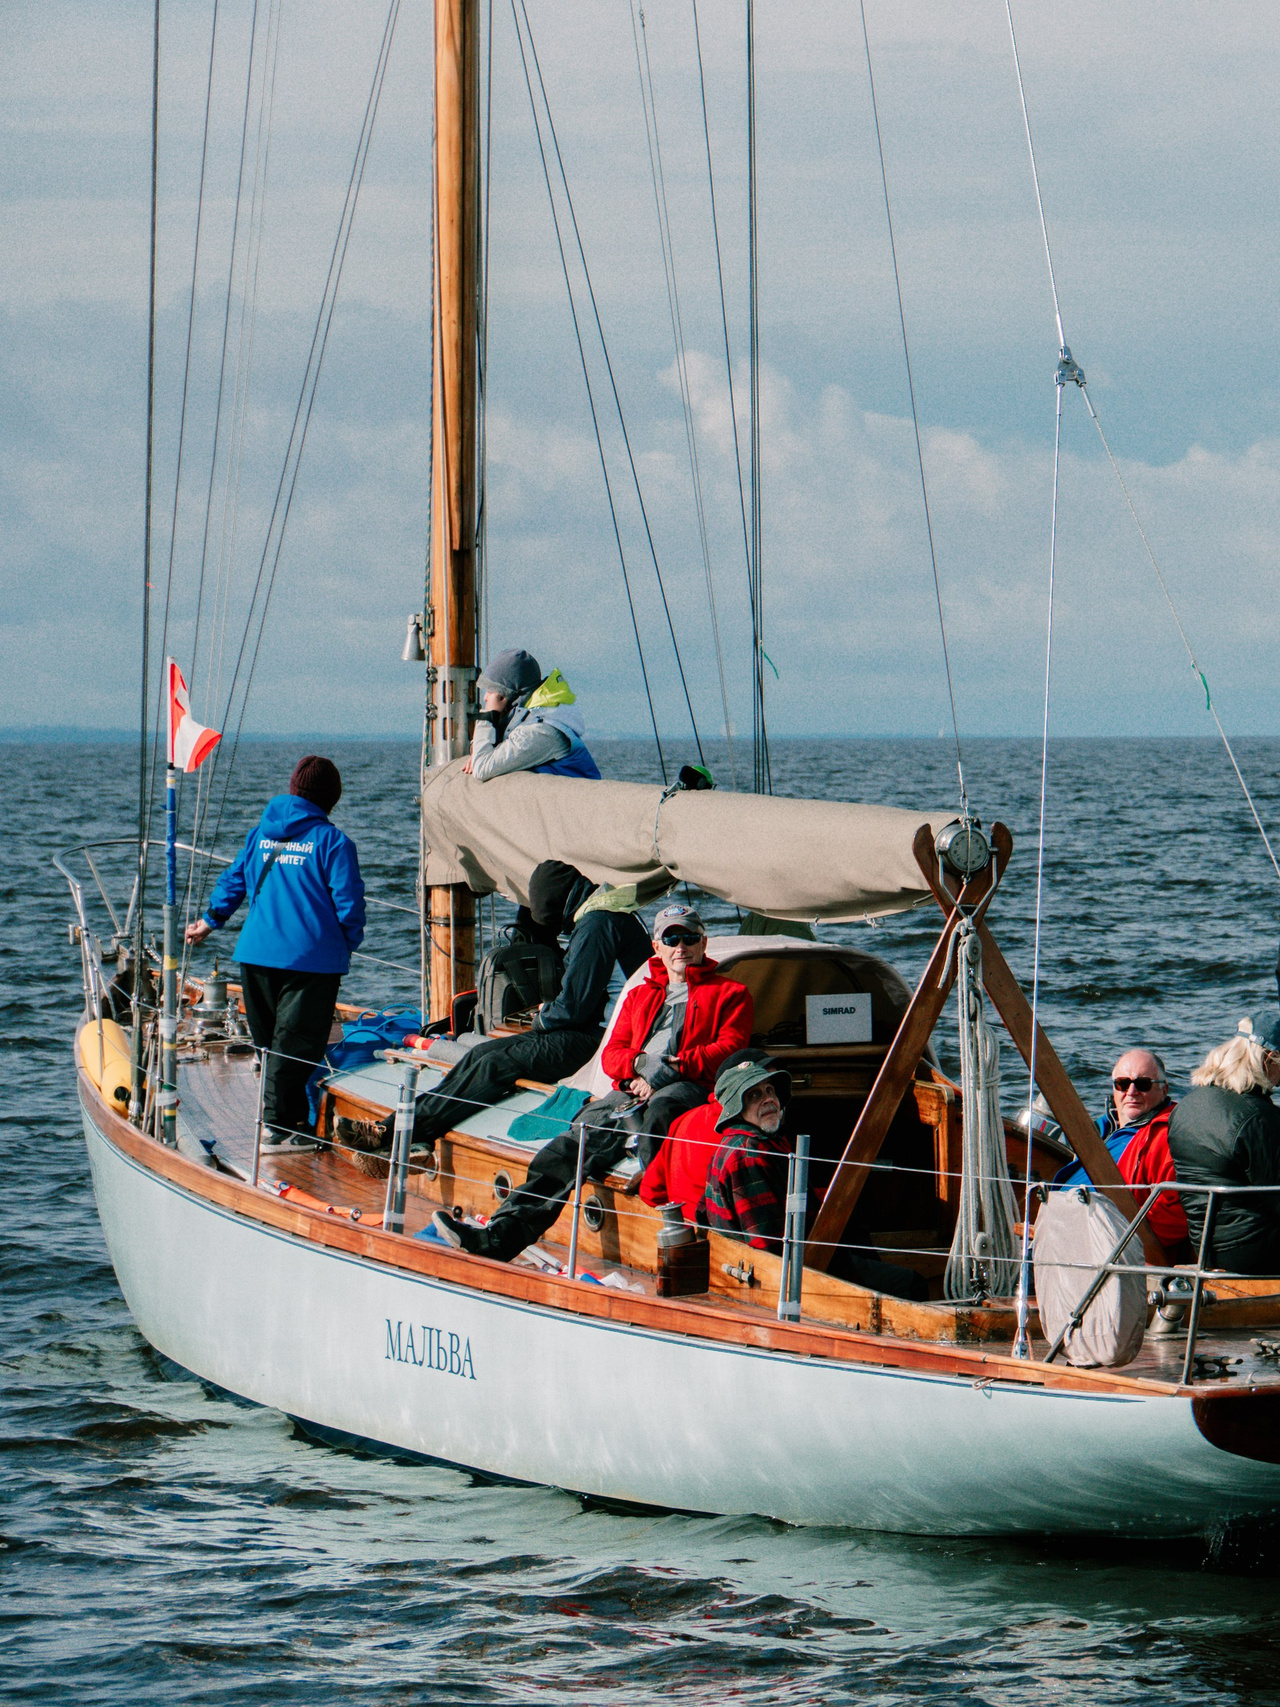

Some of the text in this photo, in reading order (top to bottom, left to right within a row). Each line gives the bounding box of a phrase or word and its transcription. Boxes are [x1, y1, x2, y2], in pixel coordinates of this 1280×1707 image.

[259, 839, 314, 854] ГОНЧНЫЙ
[262, 852, 306, 866] КМИТЕТ
[822, 1006, 856, 1015] SIMRAD
[385, 1318, 477, 1381] МАЛЬВА
